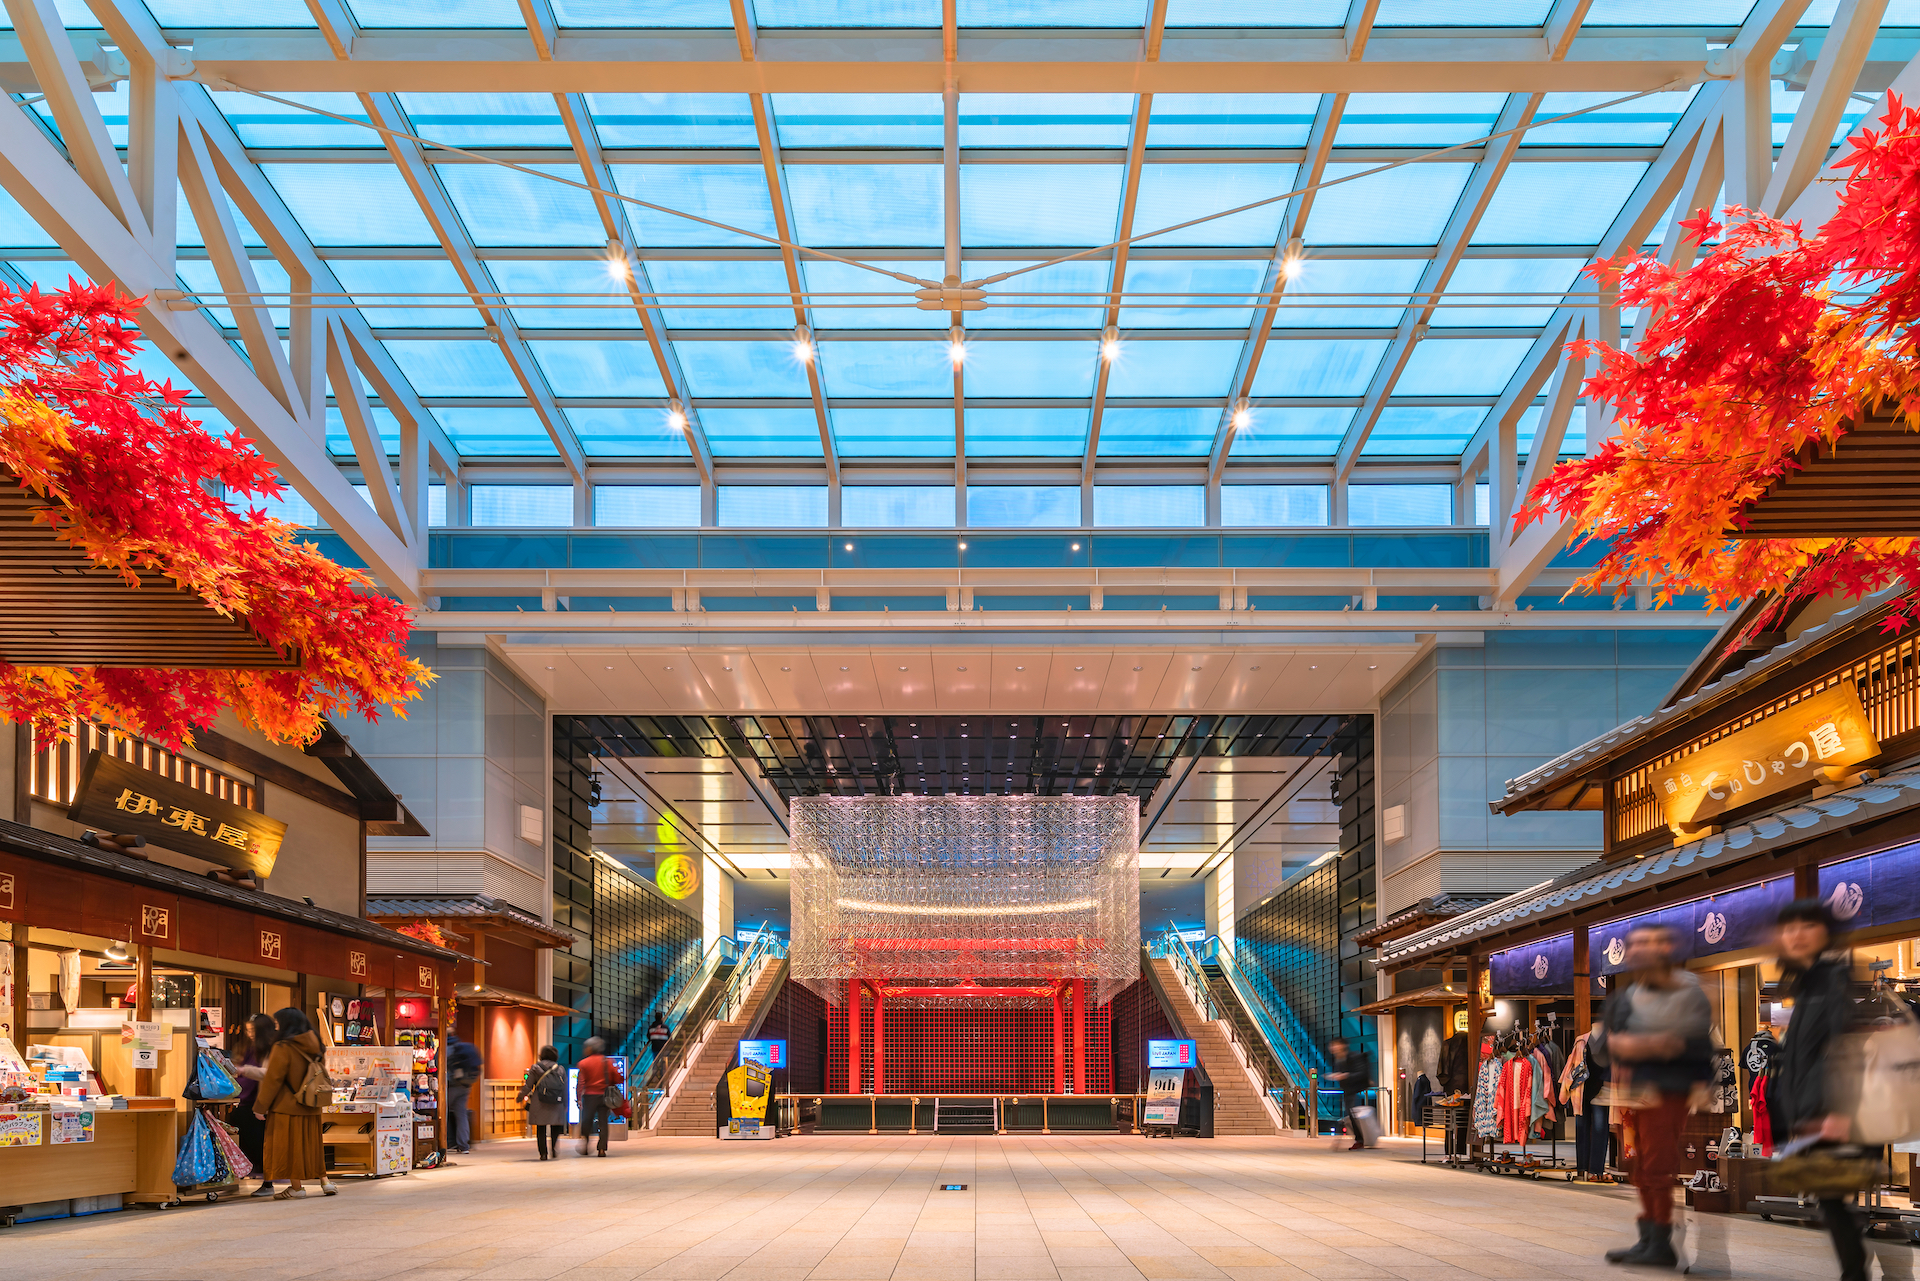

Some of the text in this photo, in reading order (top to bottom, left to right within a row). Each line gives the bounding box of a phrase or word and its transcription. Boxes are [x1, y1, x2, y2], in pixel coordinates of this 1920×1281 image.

[115, 787, 249, 851] 伊東屋
[1154, 1079, 1176, 1091] 9th
